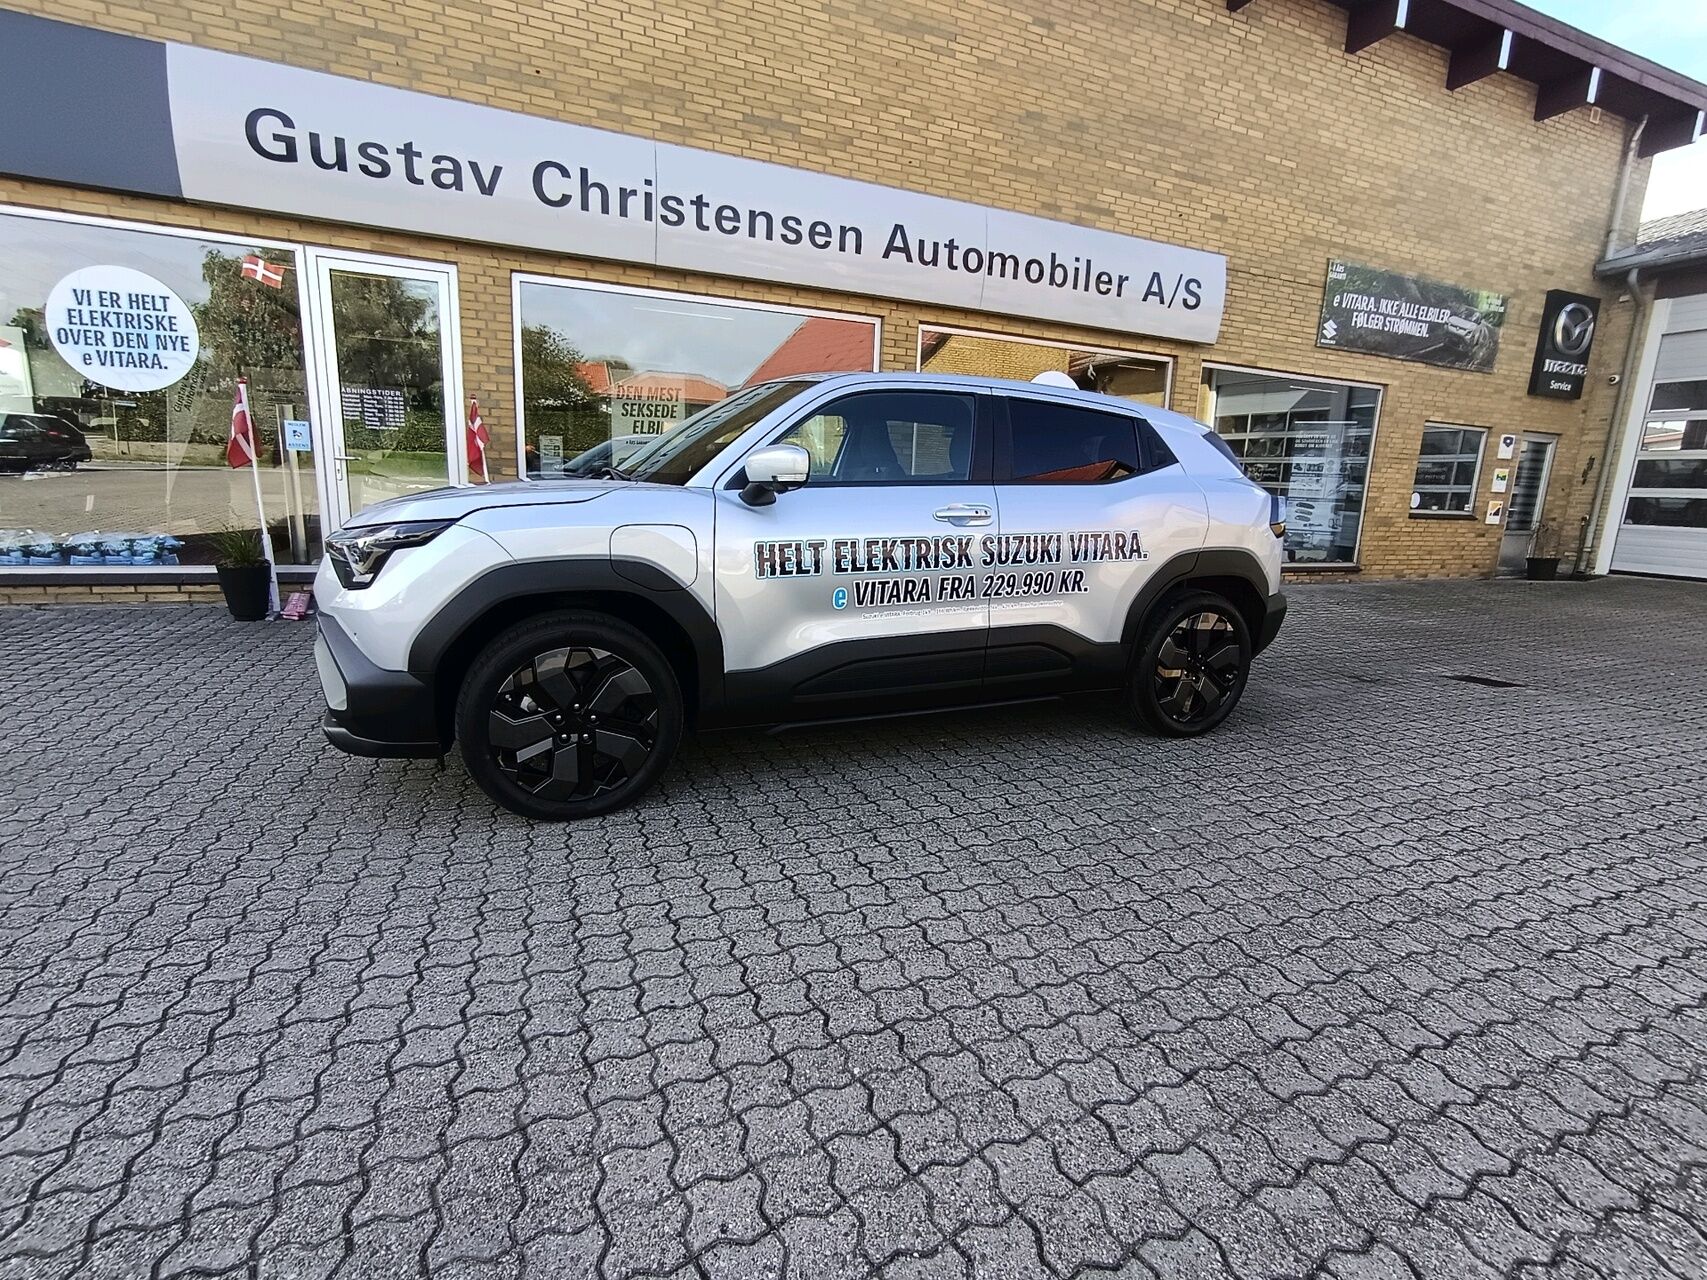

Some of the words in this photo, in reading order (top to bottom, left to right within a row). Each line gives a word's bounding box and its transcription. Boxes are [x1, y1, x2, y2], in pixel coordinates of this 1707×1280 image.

[244, 107, 503, 196] Gustav
[532, 160, 864, 255] Christensen
[882, 222, 1130, 299] Automobiler
[1141, 271, 1203, 311] A/S
[73, 288, 92, 306] VI
[98, 290, 121, 309] ER
[128, 293, 170, 312] HELT
[1333, 295, 1340, 307] e
[1342, 292, 1377, 313] VITARA.
[1378, 299, 1399, 315] IKKE
[1400, 303, 1420, 320] ALLE
[1419, 308, 1451, 324] ELBILER
[67, 308, 178, 333] ELEKTRISKE
[1351, 312, 1384, 331] FØLGER
[1384, 318, 1429, 338] STRØMMEN.
[56, 327, 107, 347] OVER
[112, 331, 148, 350] DEN
[155, 334, 190, 352] NYE
[82, 352, 93, 366] e
[95, 350, 169, 370] VITARA.
[1543, 359, 1588, 375] mazda
[616, 385, 641, 401] DEN
[646, 387, 682, 402] MEST
[1549, 380, 1572, 391] Service
[621, 402, 677, 419] SEKSEDE
[755, 541, 827, 578] HELT
[833, 535, 974, 574] ELEKTRISK
[981, 532, 1063, 567] SUZUKI
[1069, 531, 1149, 562] VITARA.
[832, 586, 848, 610] e
[853, 576, 931, 607] VITARA
[936, 574, 977, 602] FRA
[981, 570, 1056, 599] 229.990
[1057, 568, 1090, 594] KR.
